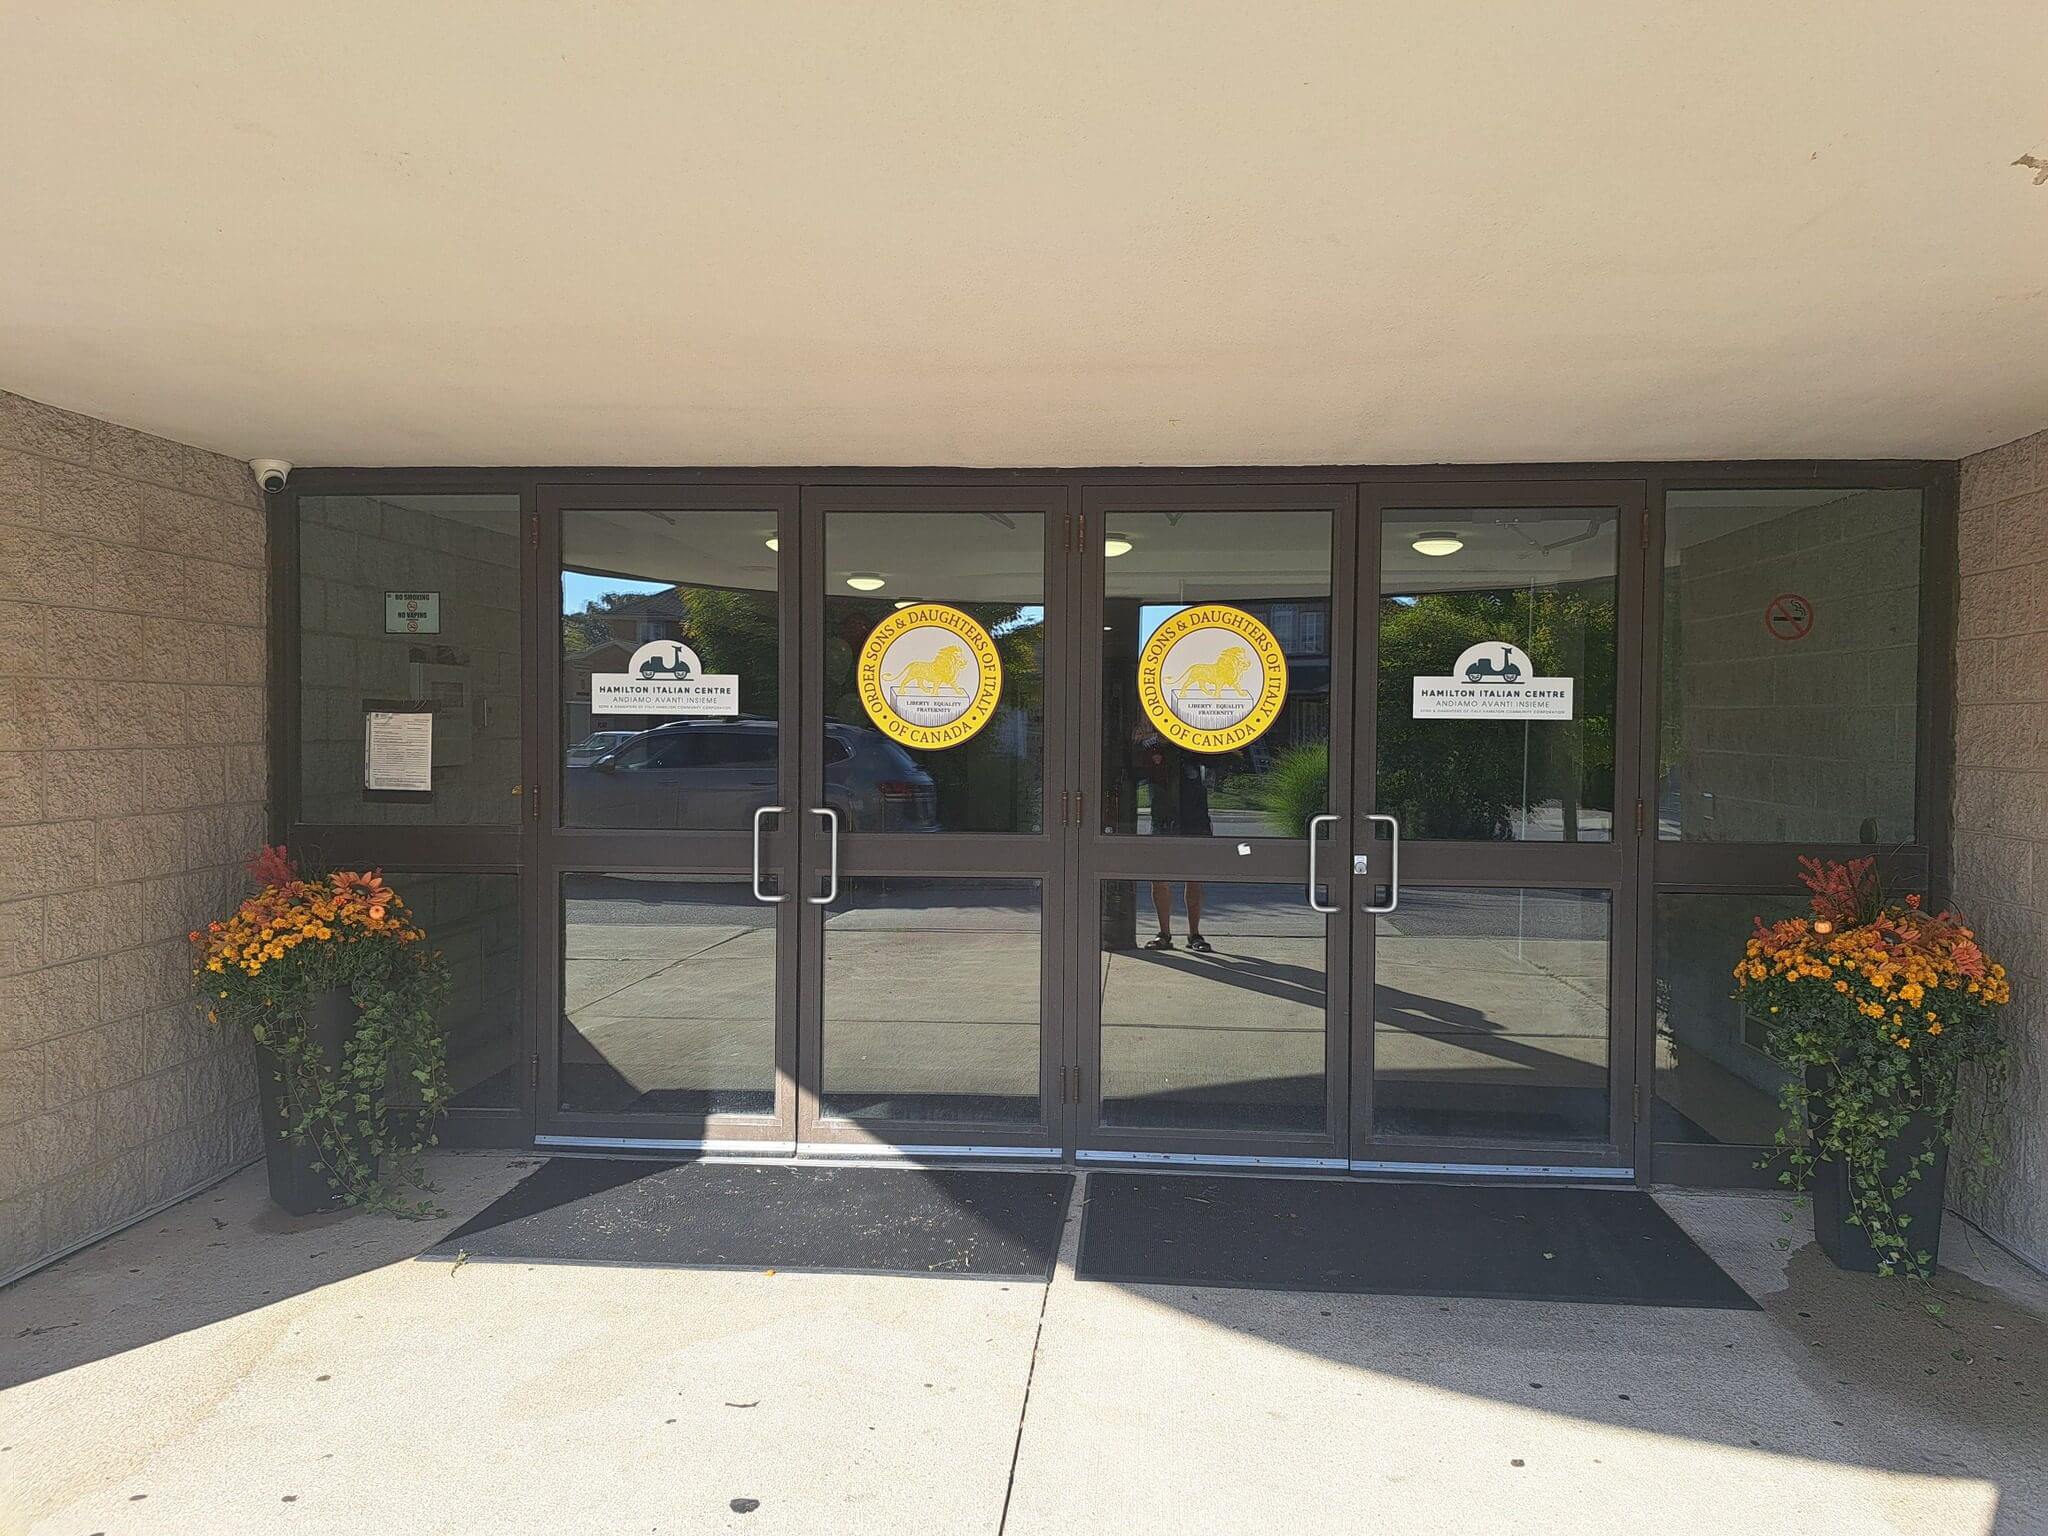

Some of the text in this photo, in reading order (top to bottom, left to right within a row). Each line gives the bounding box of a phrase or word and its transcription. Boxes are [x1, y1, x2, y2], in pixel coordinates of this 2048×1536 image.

[863, 609, 997, 716] ORDER SONS & DAUGHTERS OF ITALY
[1144, 610, 1282, 718] ORDER SONS & DAUGHTERS OF ITALY
[1422, 689, 1475, 697] HAMILTON
[888, 720, 973, 743] OF CANADA
[1170, 723, 1256, 746] OF CANADA
